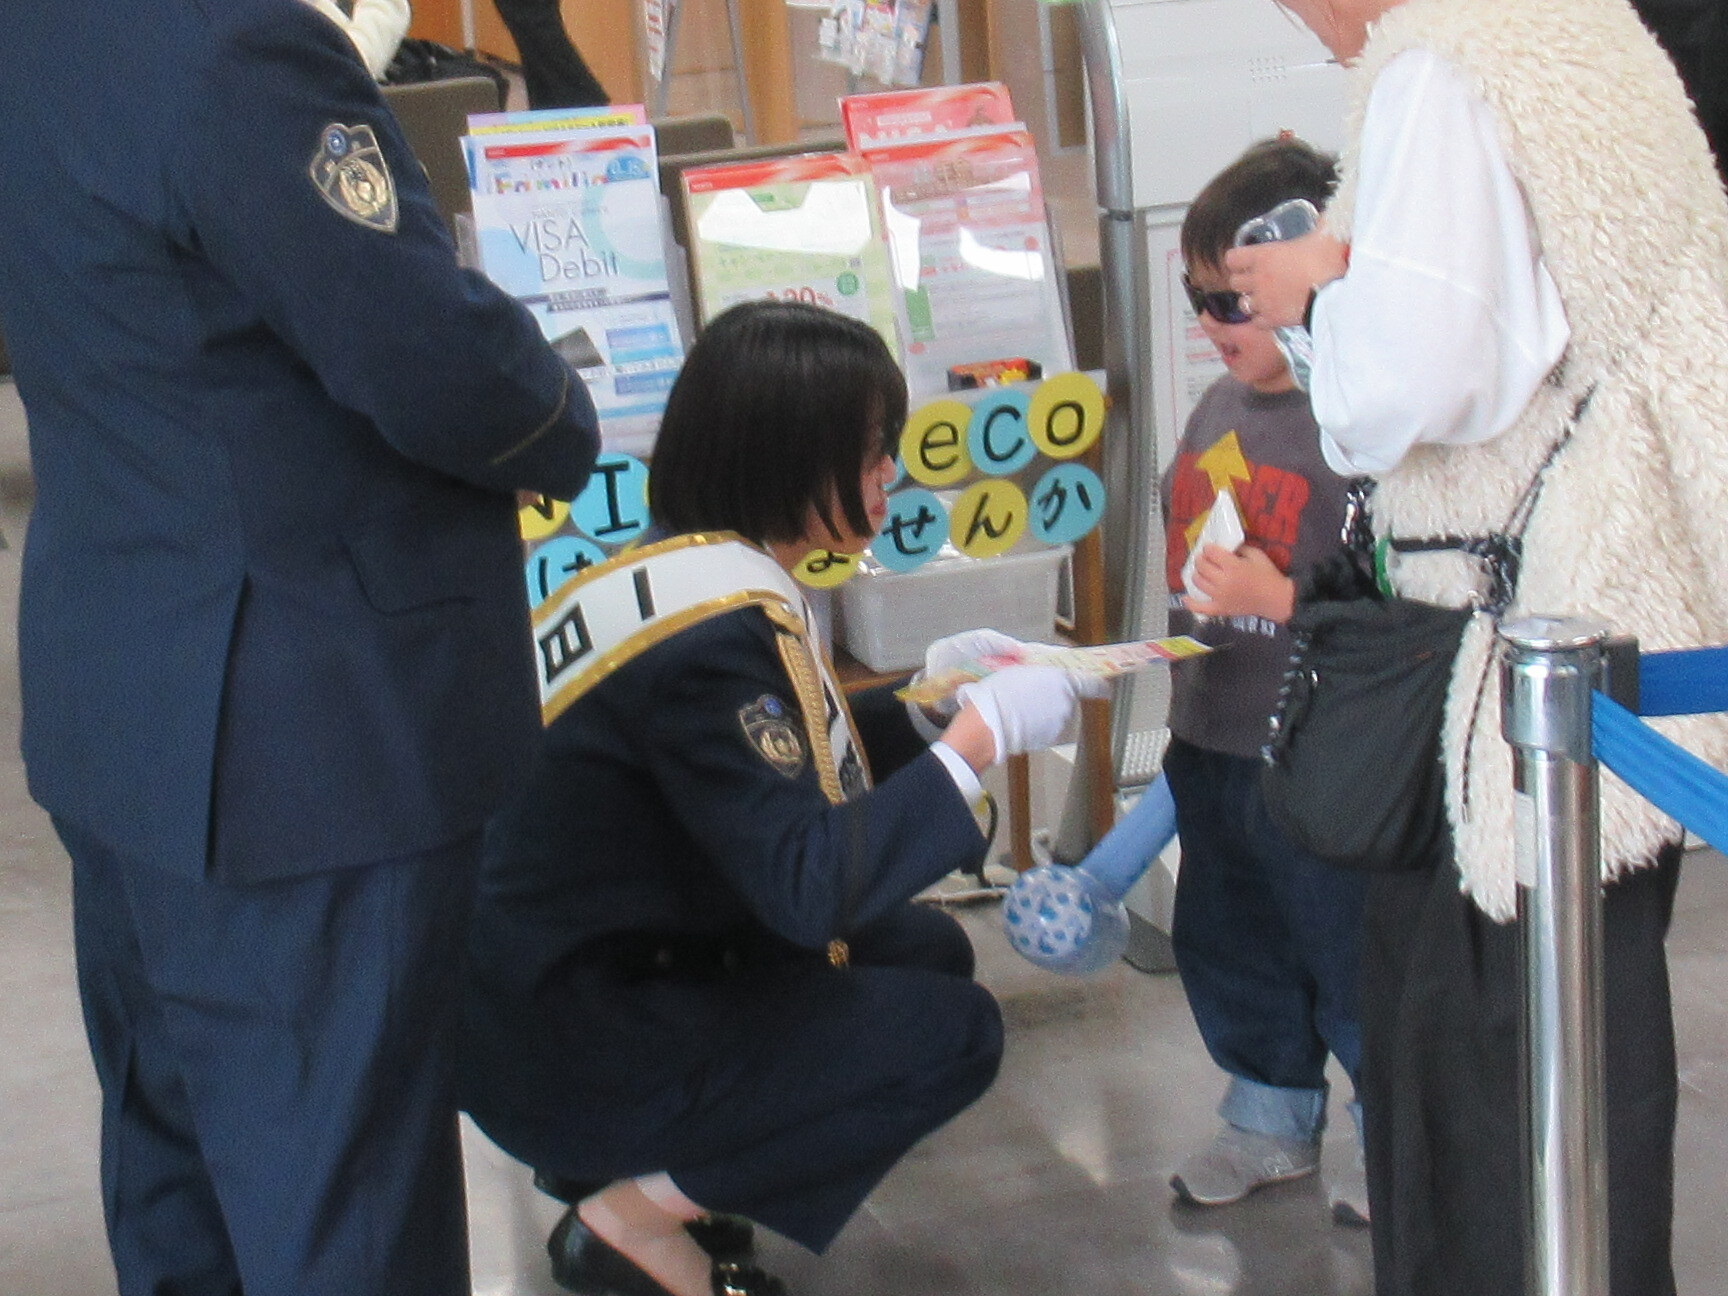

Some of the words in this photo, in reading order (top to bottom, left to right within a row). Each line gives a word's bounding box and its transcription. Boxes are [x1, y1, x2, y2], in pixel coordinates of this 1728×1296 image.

[508, 216, 590, 256] VISA
[538, 247, 620, 284] Debit
[918, 398, 1085, 472] eco
